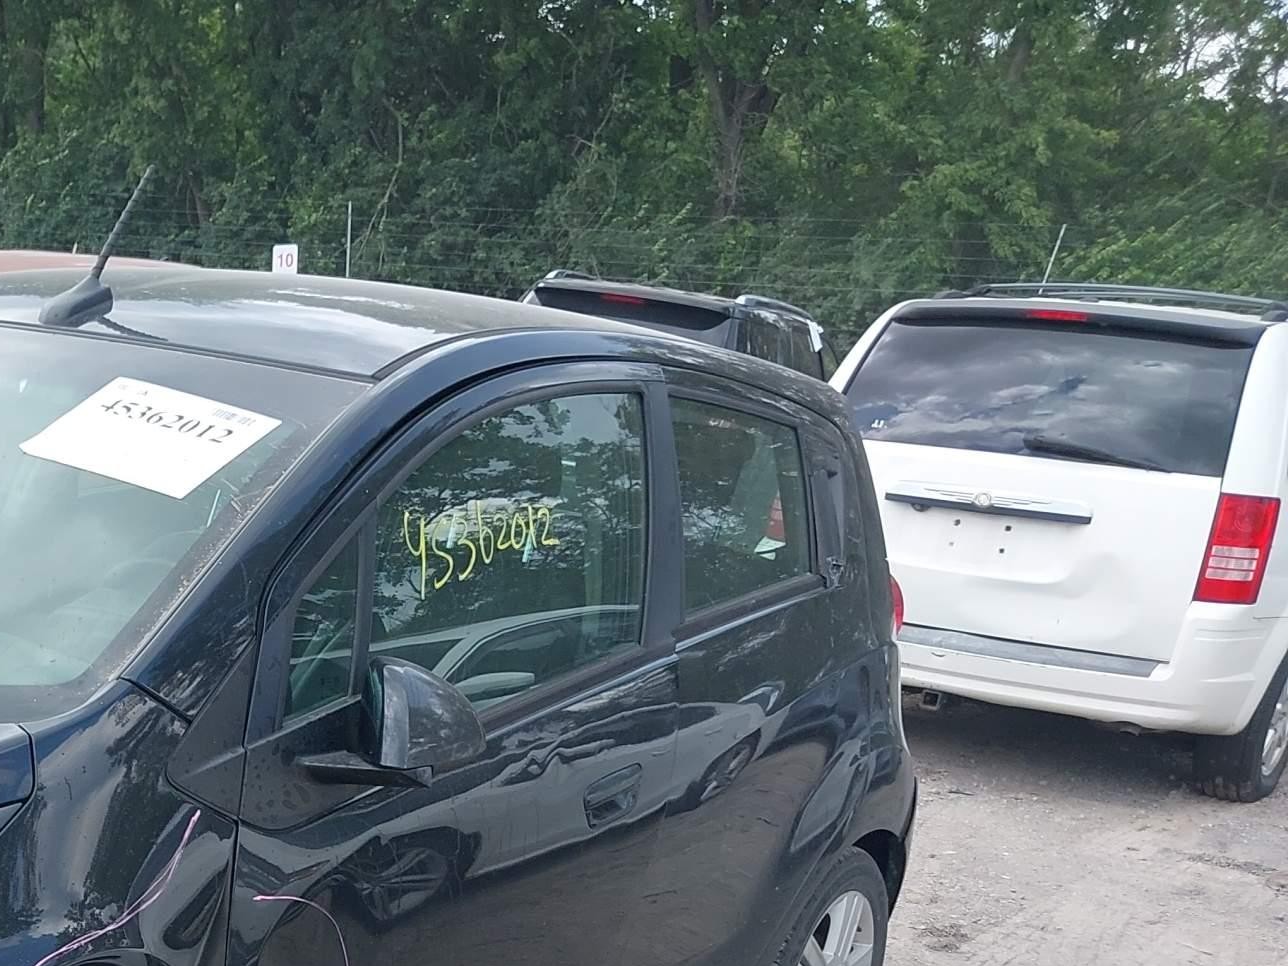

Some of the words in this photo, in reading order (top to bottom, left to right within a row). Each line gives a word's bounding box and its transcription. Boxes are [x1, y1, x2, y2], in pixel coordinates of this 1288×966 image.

[277, 253, 294, 268] 10
[101, 399, 234, 444] 45362012
[403, 500, 560, 600] 45362012
